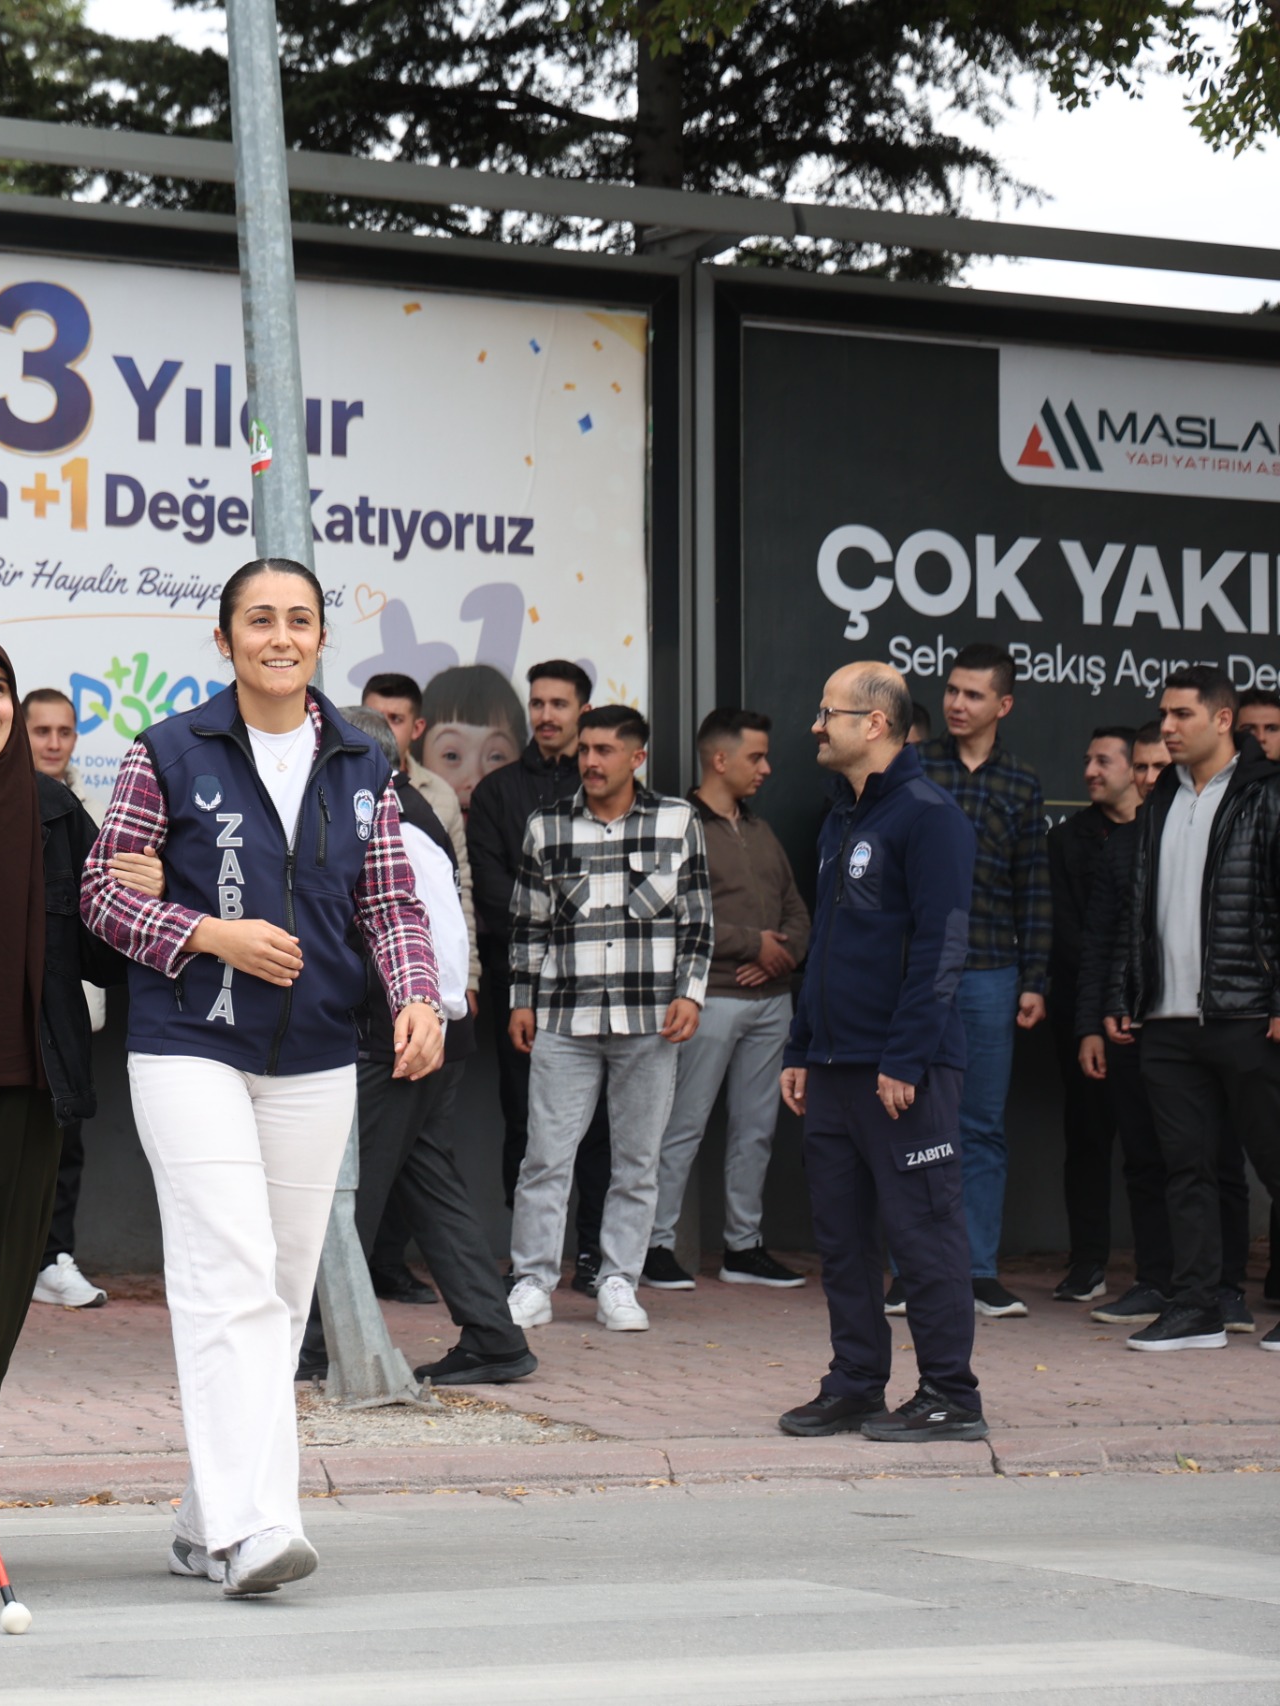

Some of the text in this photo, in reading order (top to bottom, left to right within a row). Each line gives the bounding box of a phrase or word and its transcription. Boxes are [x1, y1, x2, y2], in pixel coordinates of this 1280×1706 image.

[112, 354, 364, 458] Yılır
[1098, 408, 1280, 456] MASLA
[1126, 451, 1168, 467] YAPI
[1172, 455, 1252, 473] YATIRIM
[20, 457, 89, 532] +1
[104, 473, 256, 544] Değe
[31, 558, 128, 602] Hayalin
[817, 524, 1280, 641] ÇOK YAKI
[1009, 643, 1106, 696] Bakış
[1228, 654, 1280, 692] De
[905, 1142, 954, 1166] ZABITA
